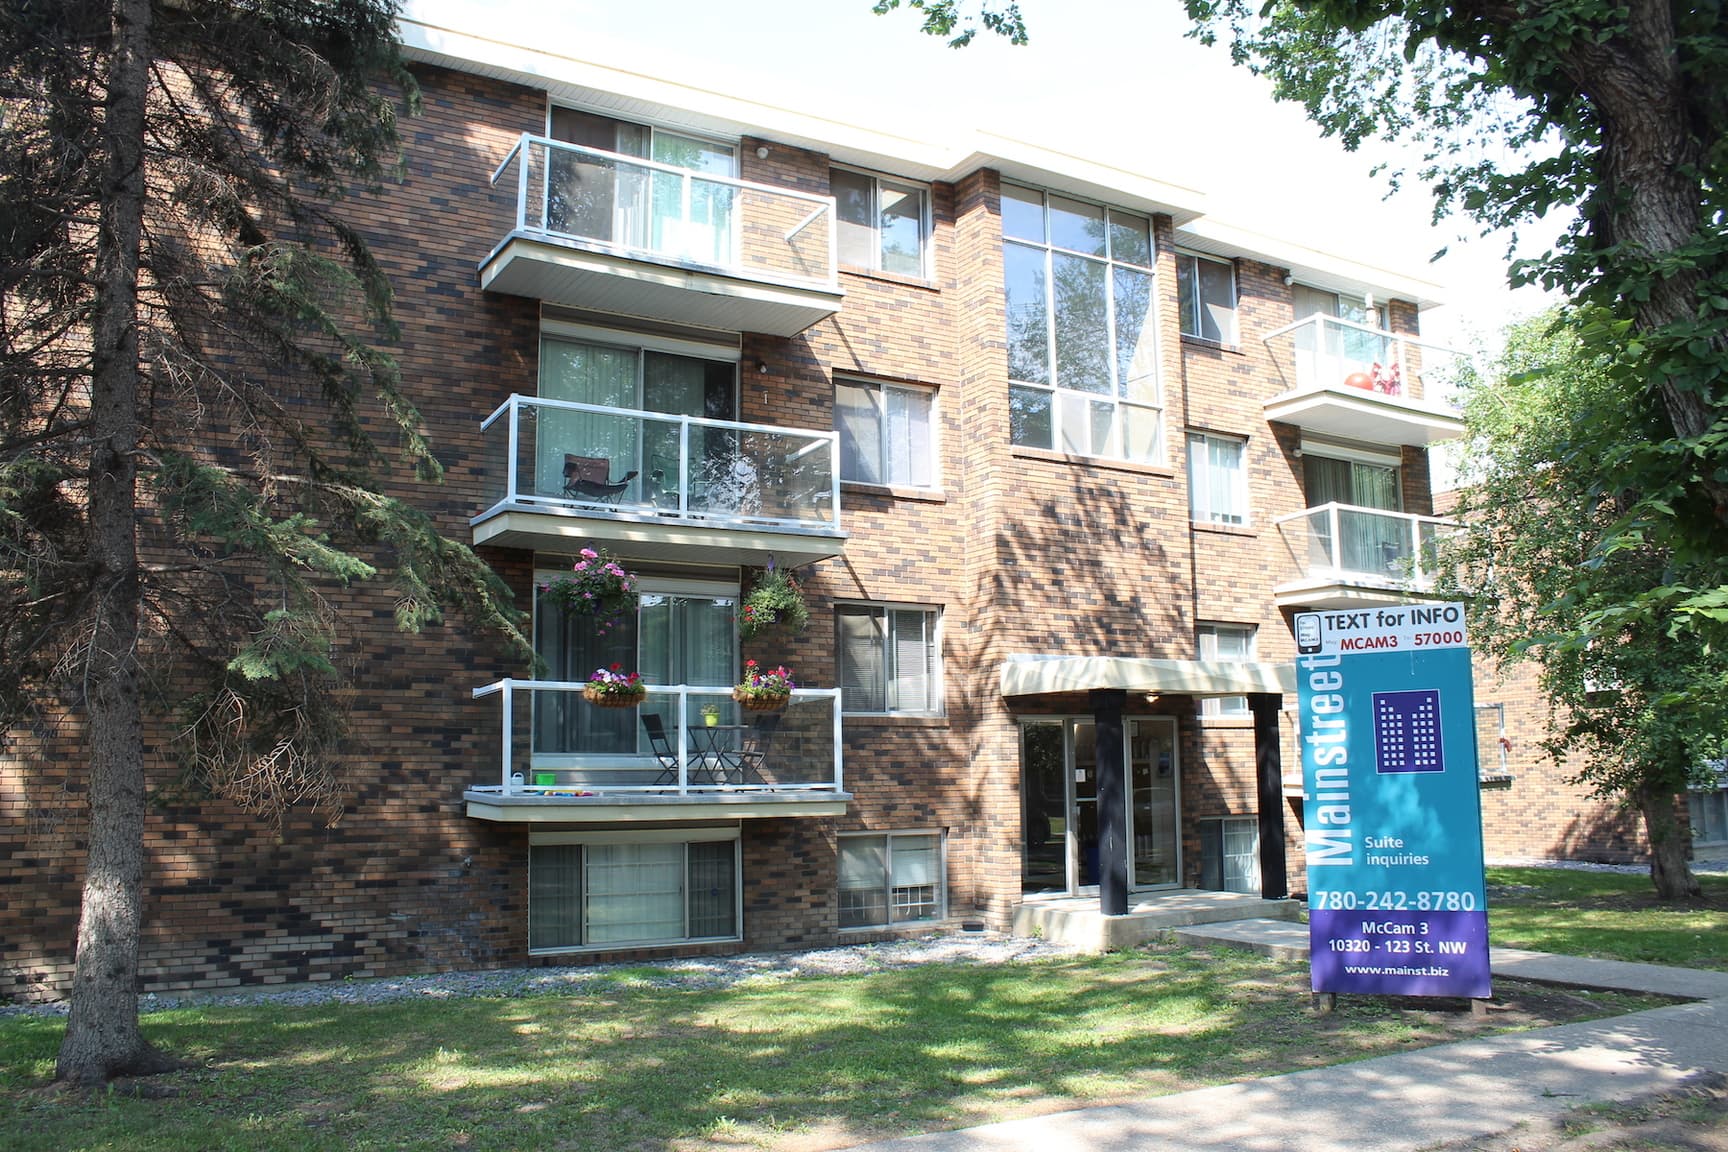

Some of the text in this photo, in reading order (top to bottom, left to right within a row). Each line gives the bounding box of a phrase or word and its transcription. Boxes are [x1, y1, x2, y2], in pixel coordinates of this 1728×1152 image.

[1325, 607, 1459, 630] TEXT for INFO
[1340, 636, 1398, 650] MCAM3
[1414, 631, 1463, 646] 57000
[1300, 654, 1353, 866] Mainstreet
[1365, 836, 1404, 849] Suite
[1366, 853, 1429, 868] inquiries
[1315, 891, 1475, 912] 780-242-8780
[1362, 922, 1429, 935] McCam 3
[1329, 939, 1370, 952] 10320
[1385, 940, 1410, 953] 123
[1415, 941, 1434, 954] St.
[1438, 941, 1467, 954] NW
[1345, 965, 1449, 977] www.mainst.biz
